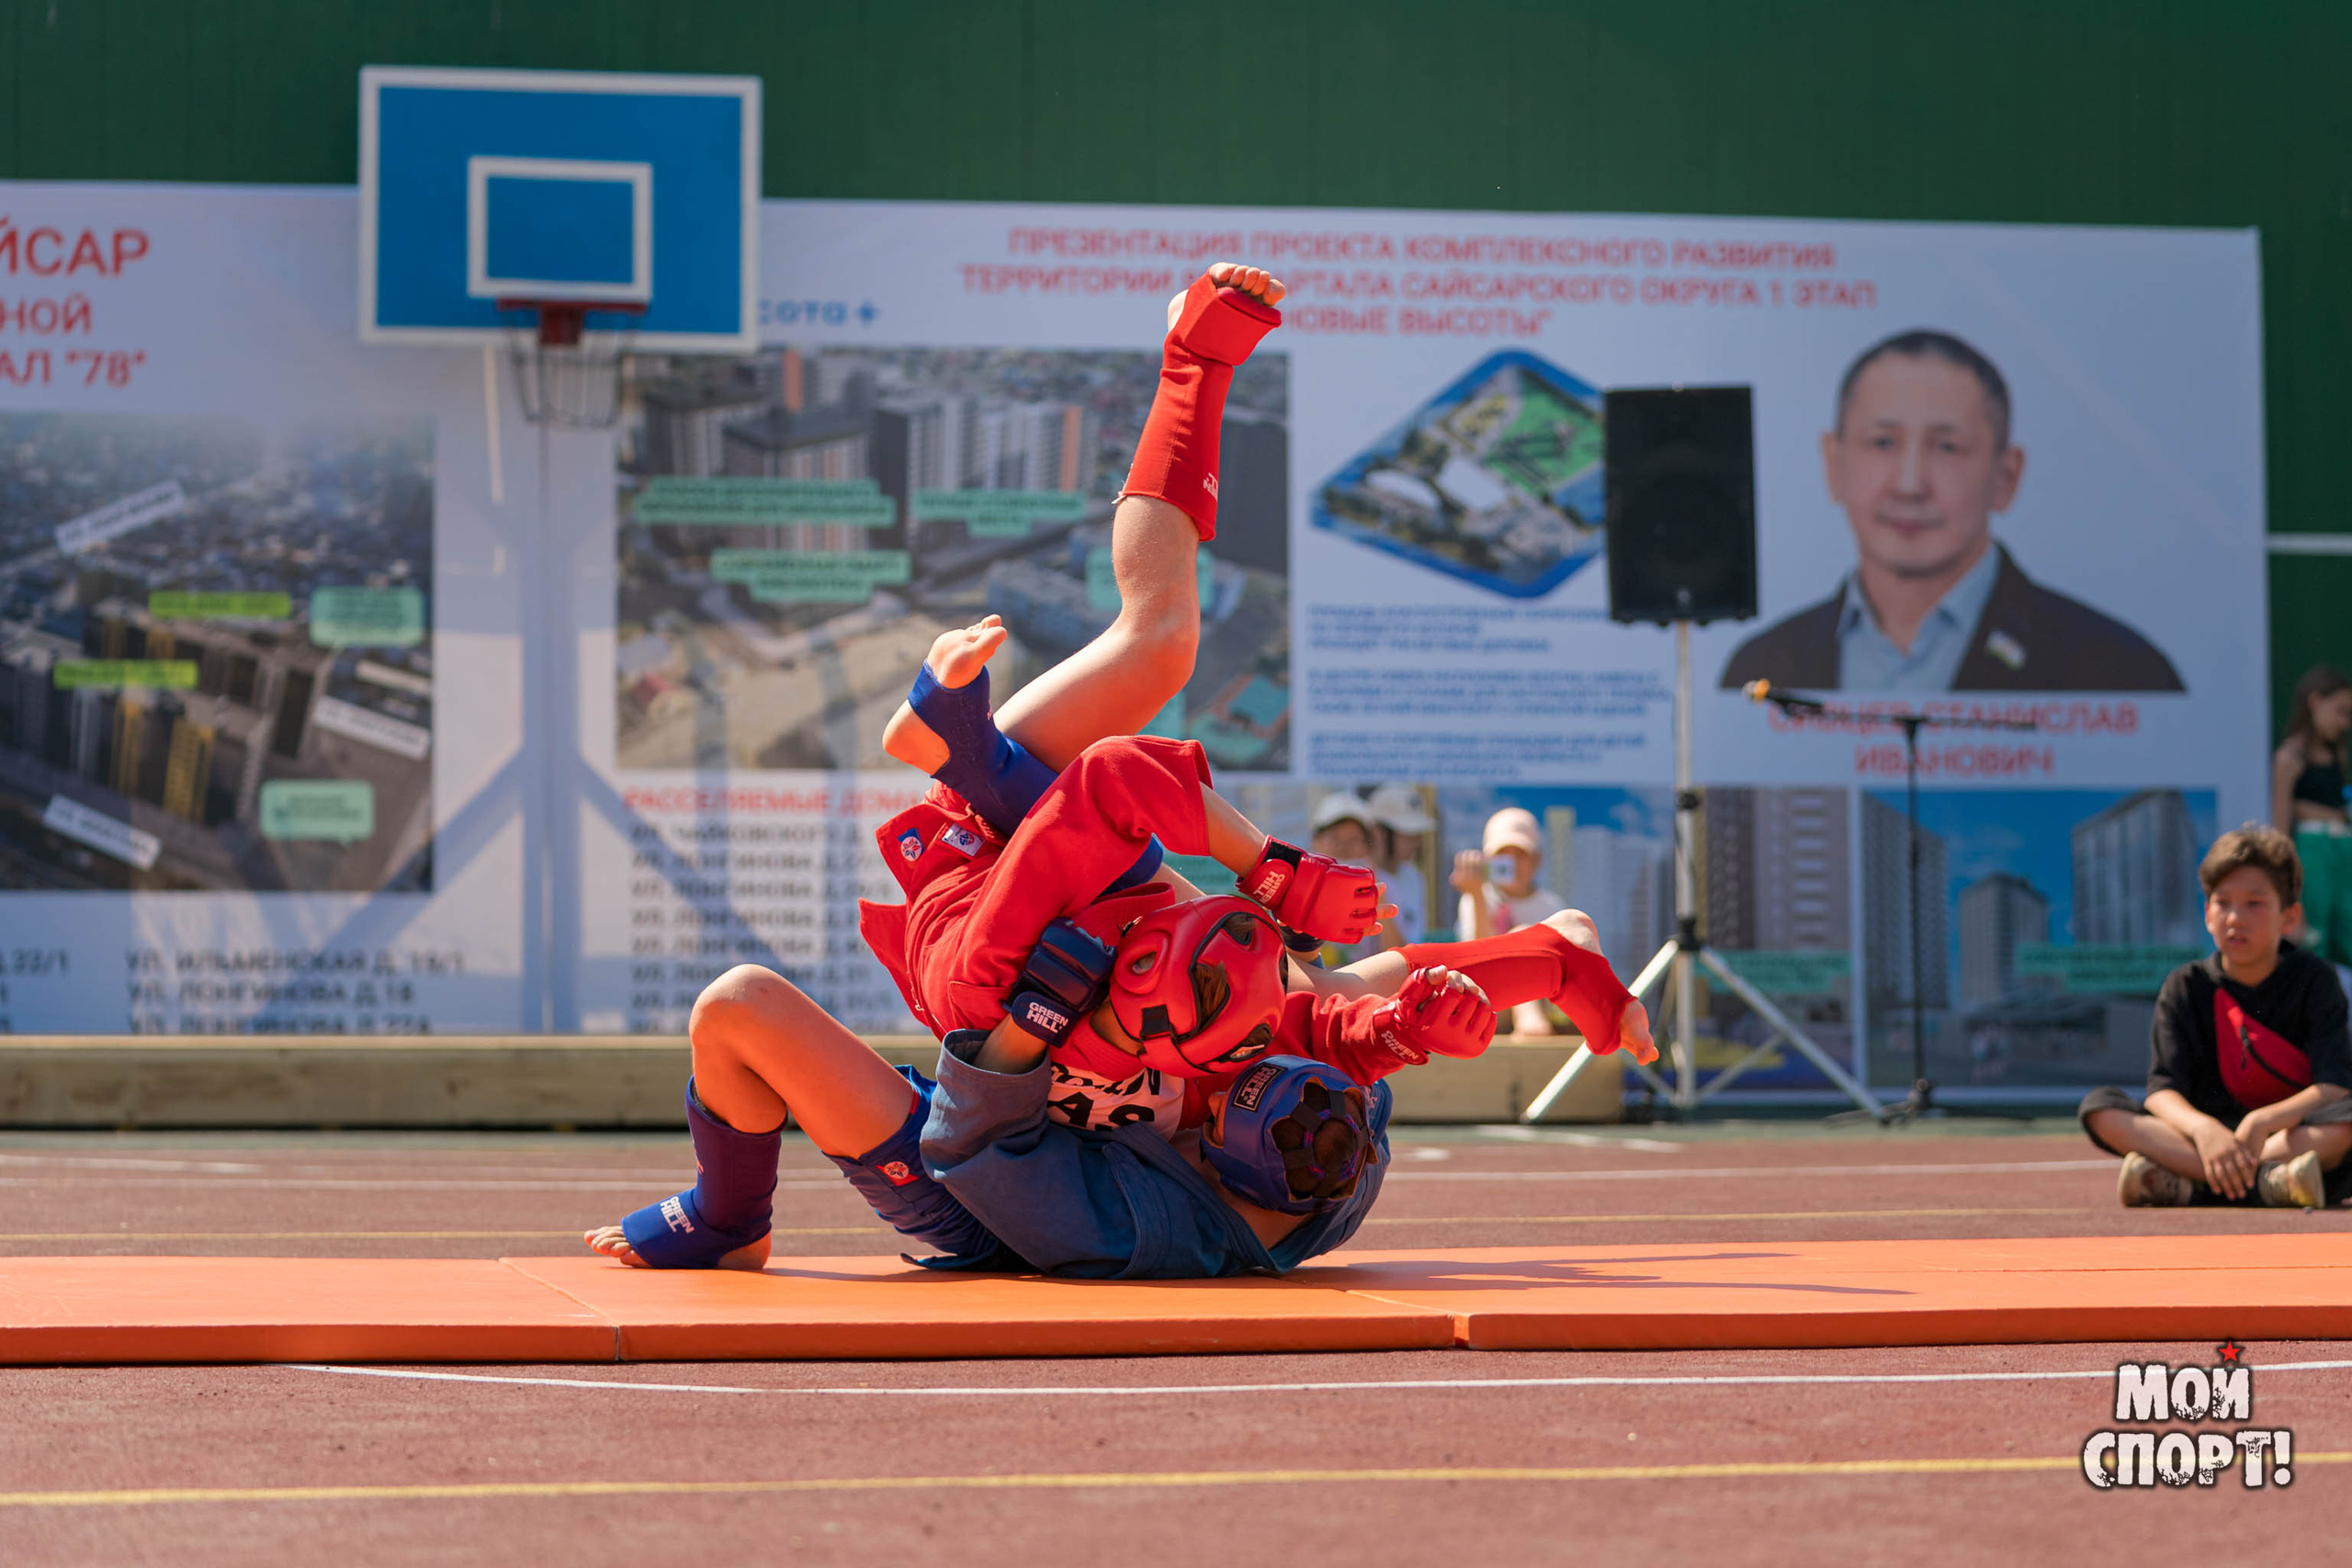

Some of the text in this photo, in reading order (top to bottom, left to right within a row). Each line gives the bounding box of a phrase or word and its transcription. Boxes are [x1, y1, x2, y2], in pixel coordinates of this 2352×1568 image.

[1008, 228, 1835, 270] ПРЕЗЕНТАЦИЯ ПРОЕКТА КОМПЛЕКСНОГО РАЗВИТИЯ
[961, 265, 1171, 295] ТЕРРИТОРИИ
[1401, 269, 1631, 304] САЙСАРСКОГО
[1640, 277, 1759, 307] ОКРУГА
[1770, 280, 1784, 308] 1
[1792, 279, 1877, 309] ЭТАП
[65, 348, 147, 389] "78"
[1921, 701, 2141, 734] СТАНИСЛАВ
[1854, 745, 2055, 777] ИВАНОВИЧ
[1253, 871, 1278, 896] HILL
[1028, 1001, 1069, 1028] GREEN
[1381, 1032, 1407, 1060] HILL
[1385, 1030, 1419, 1060] GREEN
[1246, 1068, 1277, 1106] GREEN
[660, 1200, 680, 1233] HILL
[670, 1196, 695, 1234] GREEN
